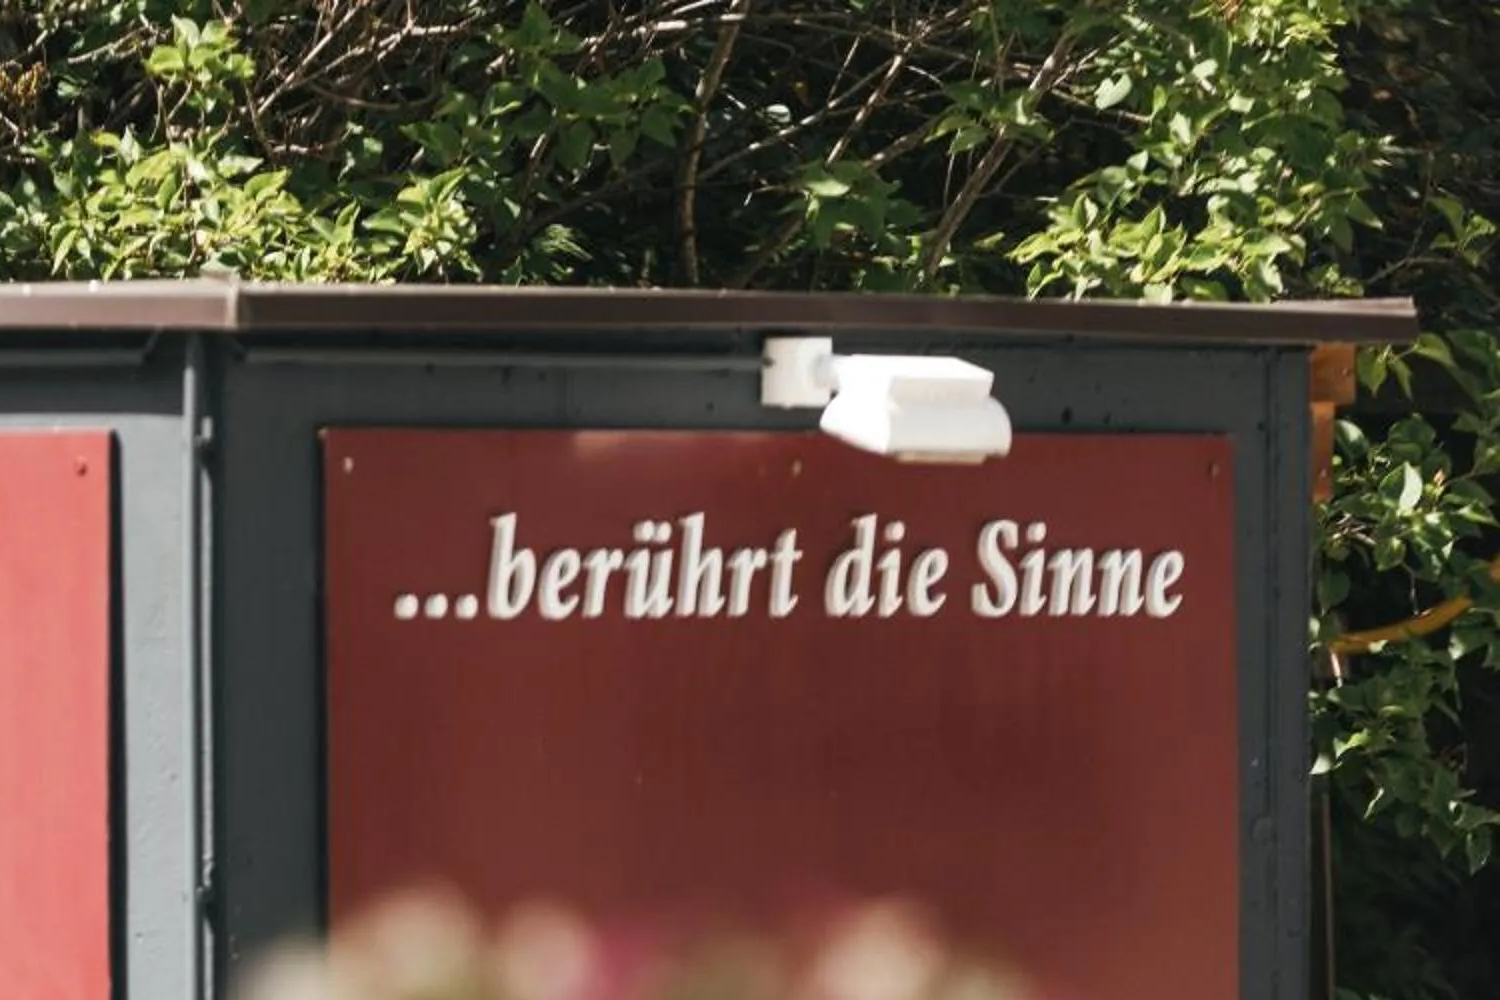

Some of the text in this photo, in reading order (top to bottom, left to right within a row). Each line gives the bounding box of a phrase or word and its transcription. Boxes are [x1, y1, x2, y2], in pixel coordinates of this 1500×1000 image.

[393, 511, 1186, 620] ...berührt die Sinne
